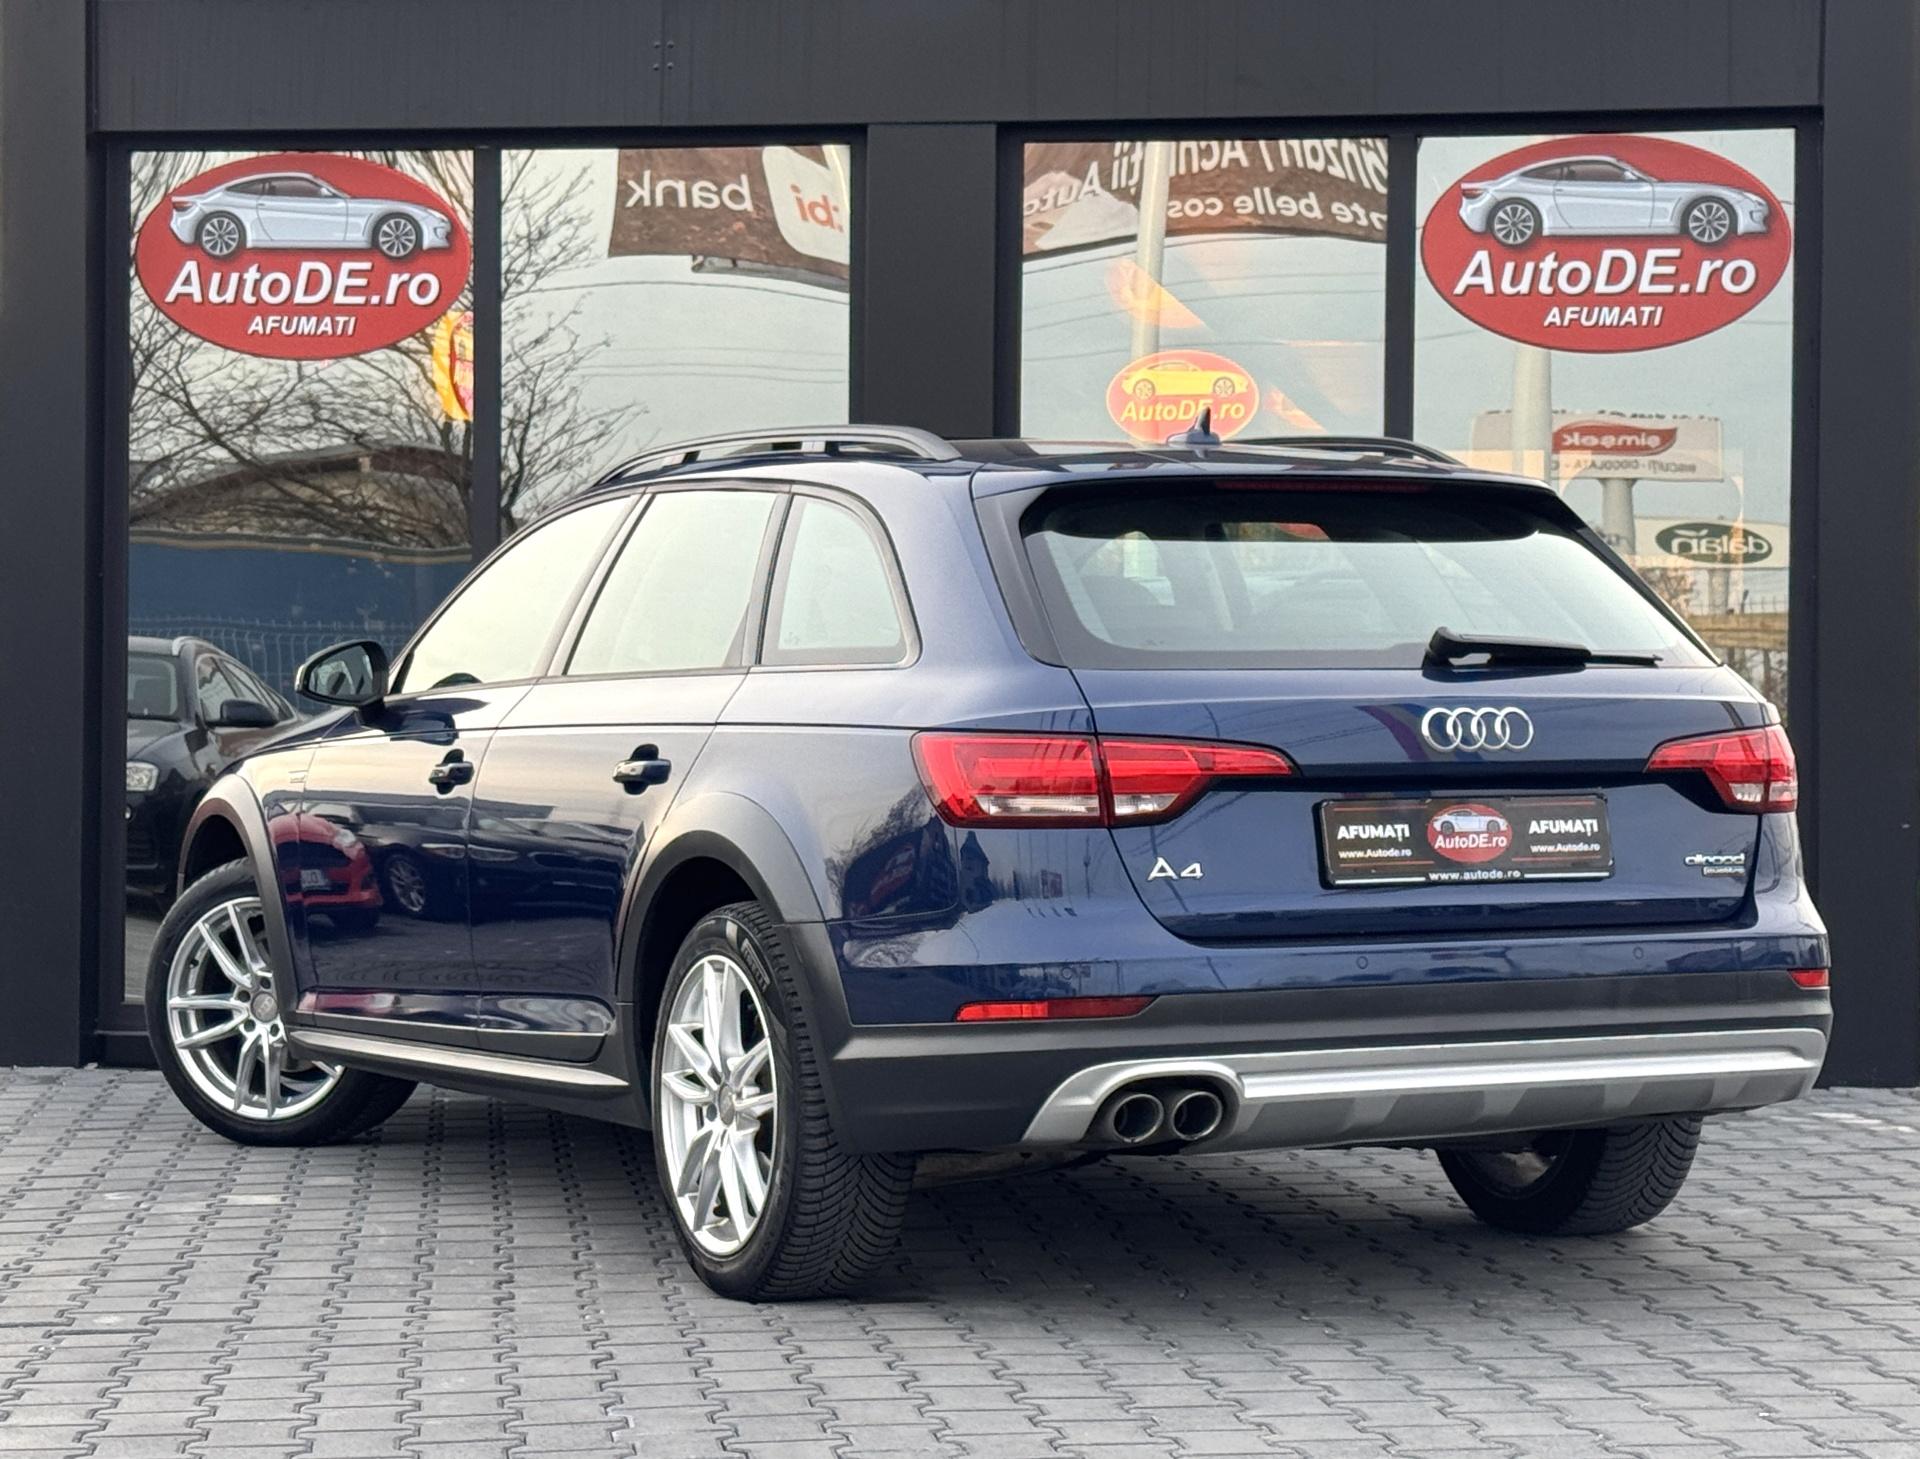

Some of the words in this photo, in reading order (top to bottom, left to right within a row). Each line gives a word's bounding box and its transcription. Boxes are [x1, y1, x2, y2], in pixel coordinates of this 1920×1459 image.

[1453, 248, 1757, 296] AutoDE.ro
[164, 260, 441, 306] AutoDE.ro
[247, 316, 356, 336] AFUMATI
[1544, 306, 1664, 327] AFUMATI
[1434, 833, 1507, 849] AutoDE.ro
[1147, 856, 1204, 881] A4
[1429, 870, 1521, 880] www.autode.ro
